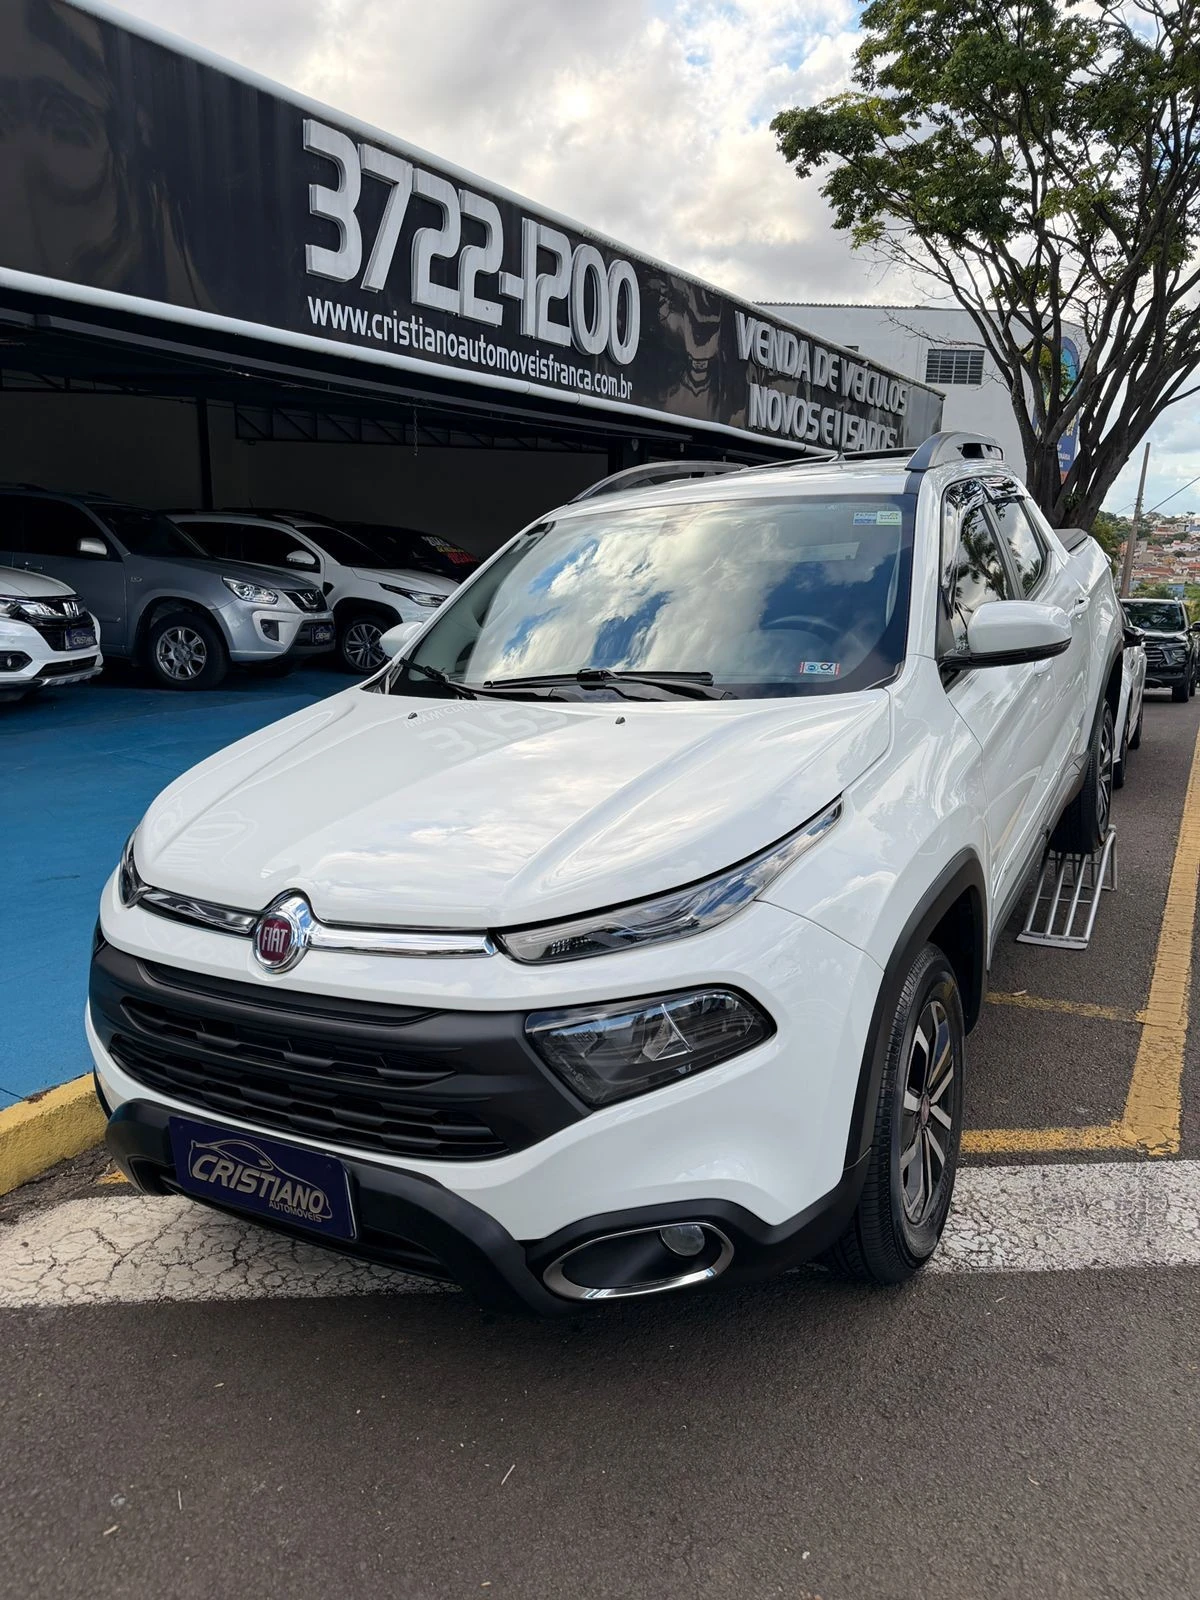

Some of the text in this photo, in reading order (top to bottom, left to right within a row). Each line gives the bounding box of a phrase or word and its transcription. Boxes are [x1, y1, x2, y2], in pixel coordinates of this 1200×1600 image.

[303, 119, 641, 366] 3722-1200
[307, 296, 632, 399] www.cristianoautomoveisfranca.com.br
[735, 311, 811, 382] VENDA
[813, 346, 840, 392] DE
[749, 384, 821, 441] NOVOS
[821, 407, 836, 446] E
[262, 927, 288, 953] FIAT
[192, 1155, 325, 1214] CRISTIANO
